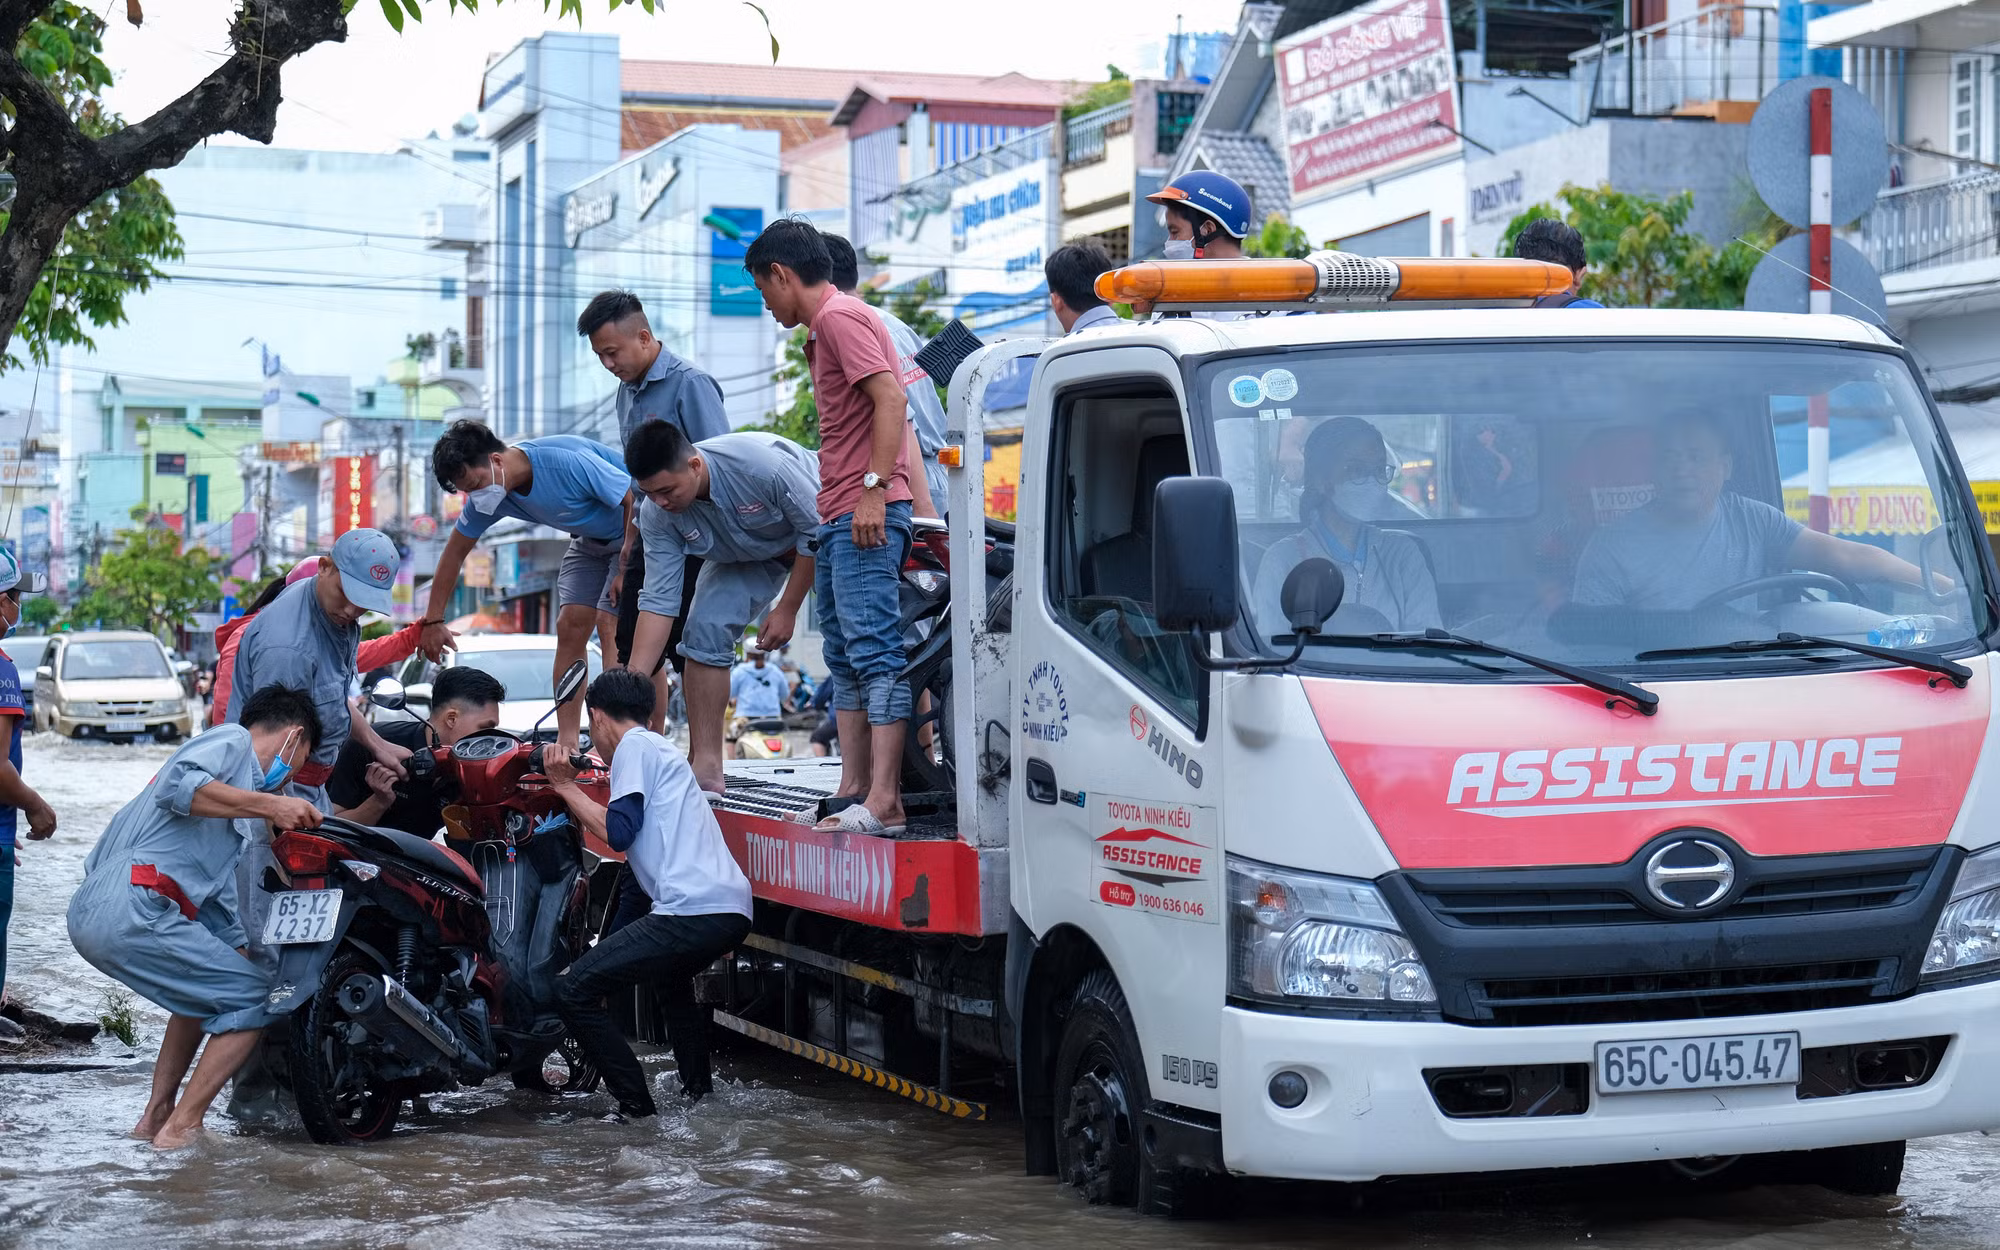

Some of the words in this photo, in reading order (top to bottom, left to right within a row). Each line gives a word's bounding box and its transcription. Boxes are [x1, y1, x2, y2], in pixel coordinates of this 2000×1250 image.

[1198, 188, 1232, 210] Sacombank
[1235, 385, 1258, 393] 11/2022
[1868, 497, 1926, 528] DUNG
[1028, 661, 1048, 690] TNHH
[1049, 665, 1069, 738] TOYOTA
[1029, 722, 1042, 740] NINH
[1147, 725, 1204, 789] HINO
[1446, 736, 1902, 804] ASSISTANCE
[1108, 802, 1142, 822] TOYOTA
[1144, 808, 1165, 825] NINH
[1168, 805, 1191, 829] KIỀU
[746, 832, 792, 888] TOYOTA
[795, 839, 826, 896] NINH
[829, 837, 860, 904] KIỀU
[1103, 845, 1202, 874] ASSISTANCE
[278, 894, 329, 916] 65-X2
[1109, 886, 1119, 899] Hỗ
[1139, 893, 1161, 909] 1900
[1163, 897, 1181, 913] 636
[1184, 902, 1204, 916] 046
[274, 917, 327, 940] 4237
[1162, 1054, 1191, 1084] 150
[1192, 1059, 1218, 1089] PS
[1603, 1036, 1793, 1089] 65C-045.47
